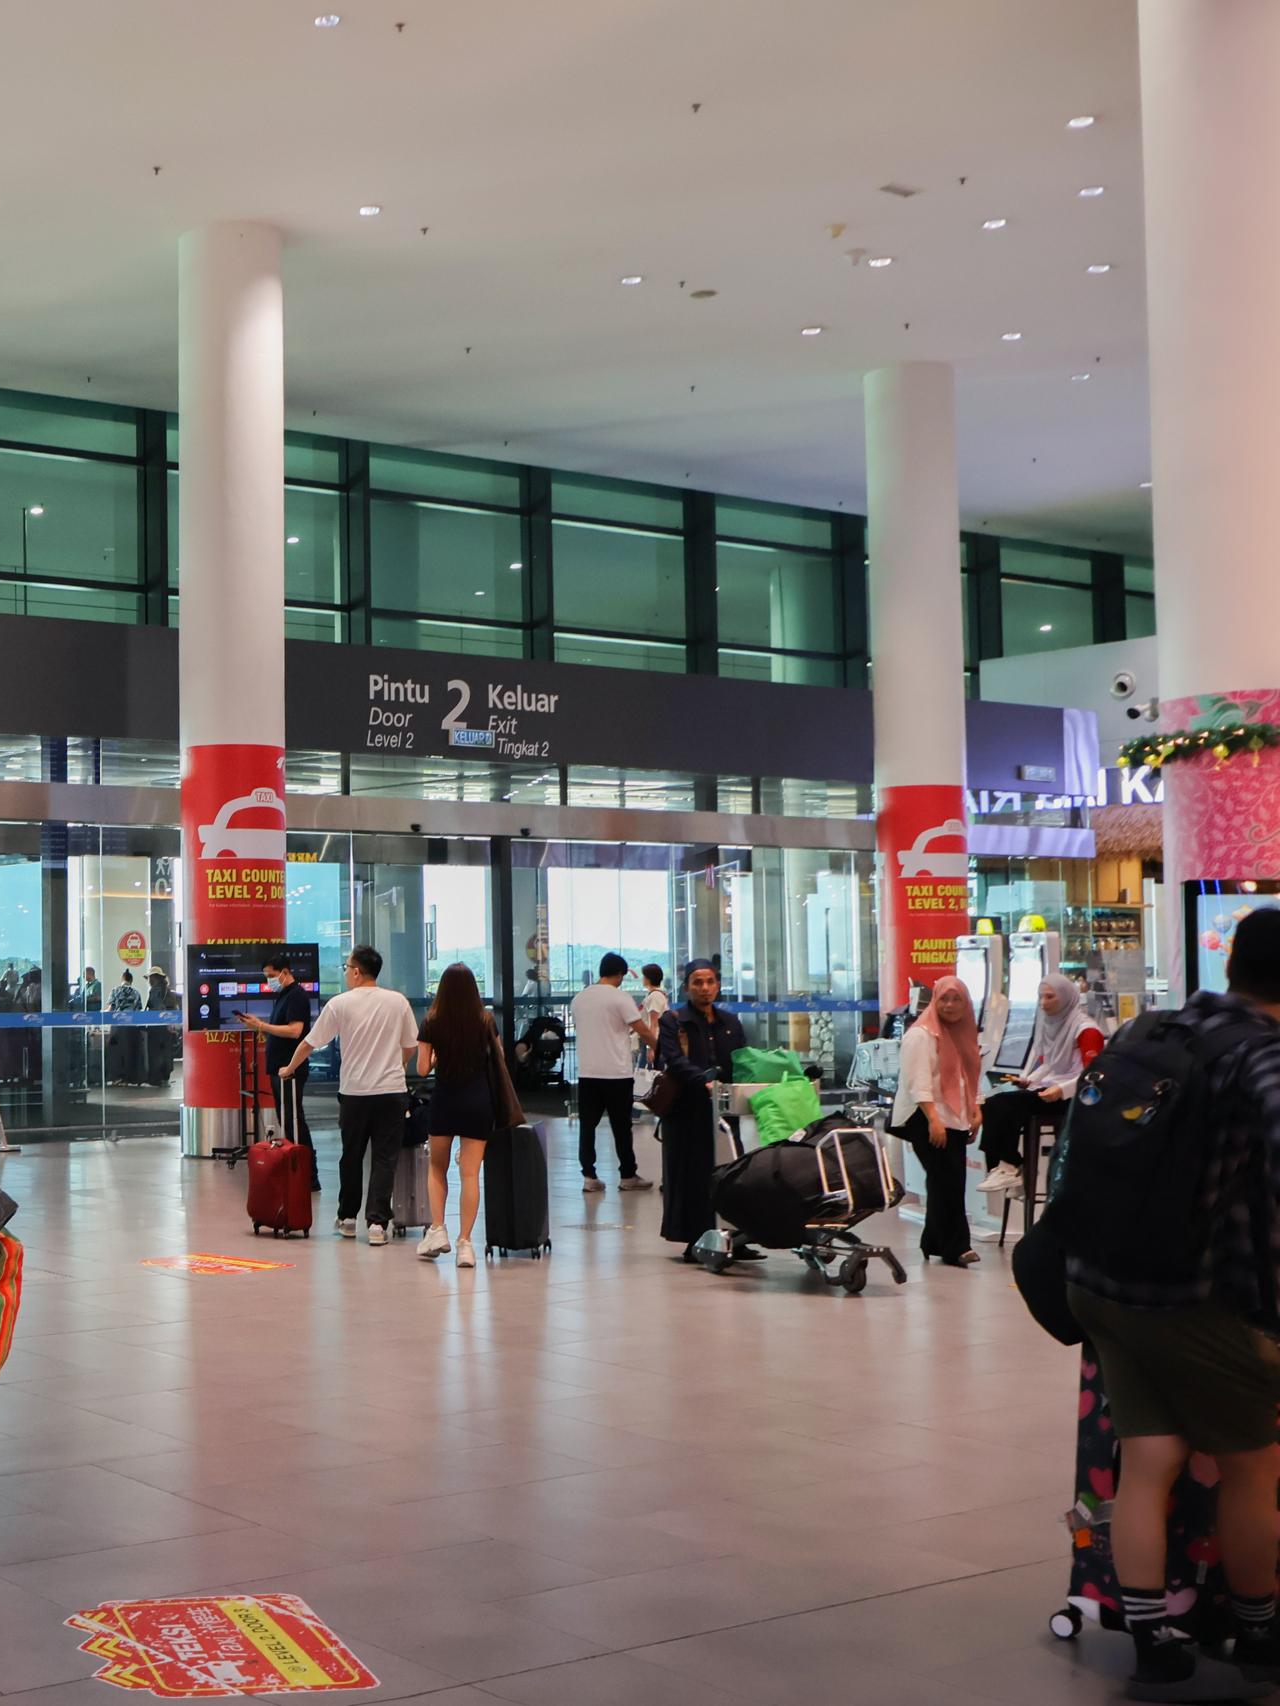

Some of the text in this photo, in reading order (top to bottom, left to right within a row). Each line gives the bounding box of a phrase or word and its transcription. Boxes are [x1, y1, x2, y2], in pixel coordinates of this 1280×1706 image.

[369, 674, 429, 704] Pintu
[488, 684, 559, 713] Keluar
[441, 679, 470, 730] 2
[369, 707, 413, 728] Door
[488, 715, 517, 735] Exit
[366, 730, 414, 748] Level 2
[454, 731, 484, 745] KELUAR
[497, 738, 549, 759] Tingkat 2
[257, 792, 273, 803] TAXI
[206, 869, 237, 883] TAXI
[208, 885, 251, 899] LEVEL
[255, 885, 267, 902] 2,
[905, 885, 933, 896] TAXI
[908, 898, 959, 911] LEVEL 2,
[238, 1613, 270, 1635] DOOR
[268, 1642, 299, 1665] LEVEL
